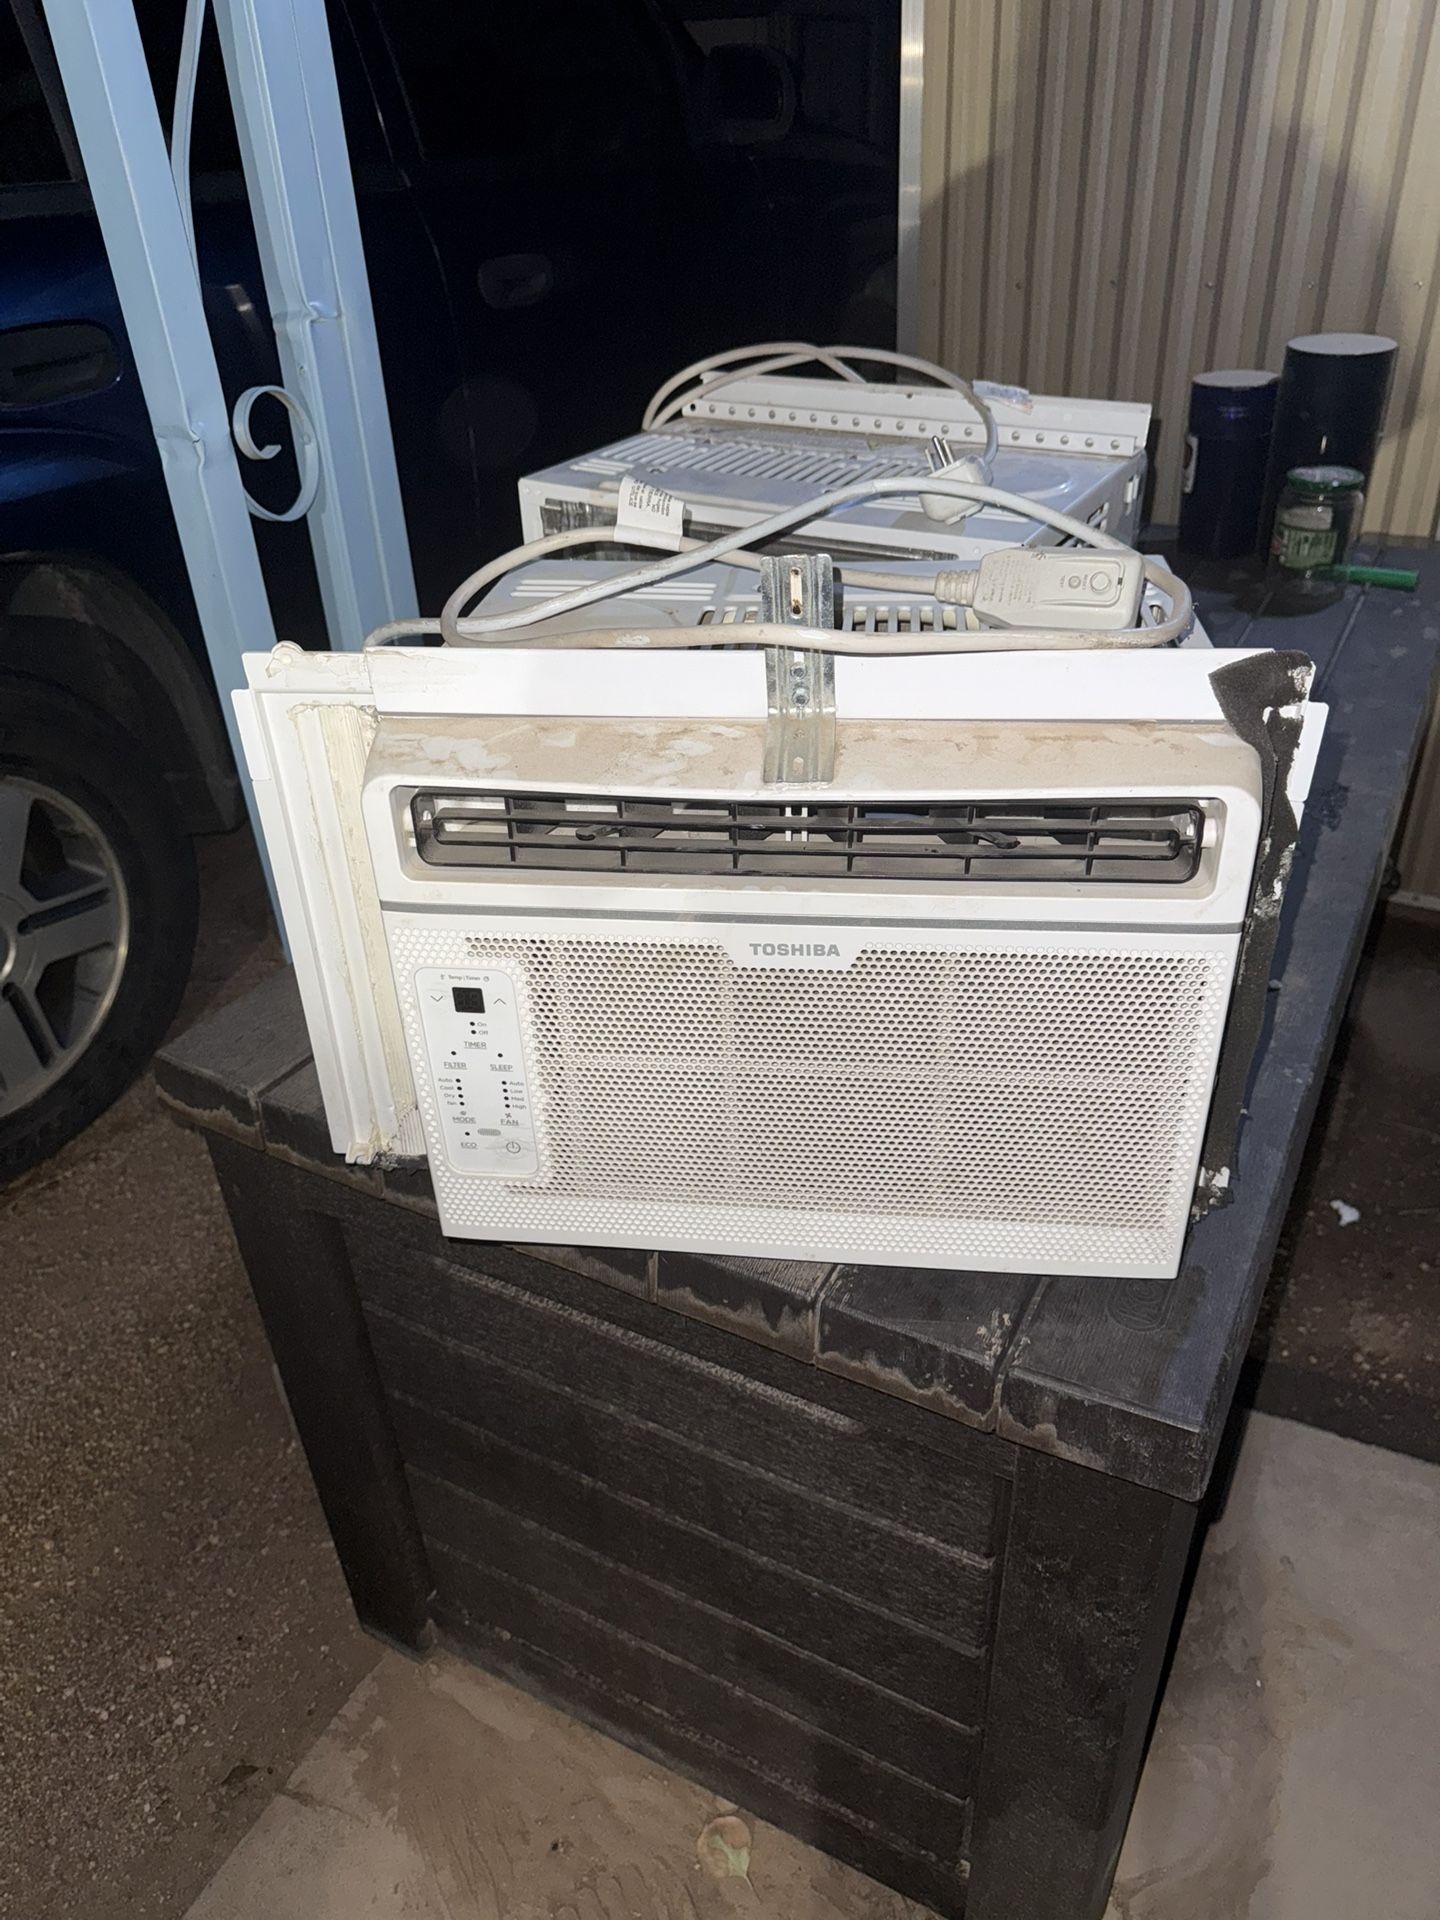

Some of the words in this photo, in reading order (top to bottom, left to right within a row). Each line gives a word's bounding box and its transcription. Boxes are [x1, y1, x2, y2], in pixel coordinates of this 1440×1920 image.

[749, 943, 840, 957] TOSHIBA
[464, 1041, 487, 1049] TIMER
[443, 1061, 467, 1069] FILTER
[490, 1064, 513, 1072] SLEEP
[452, 1116, 476, 1124] MODE
